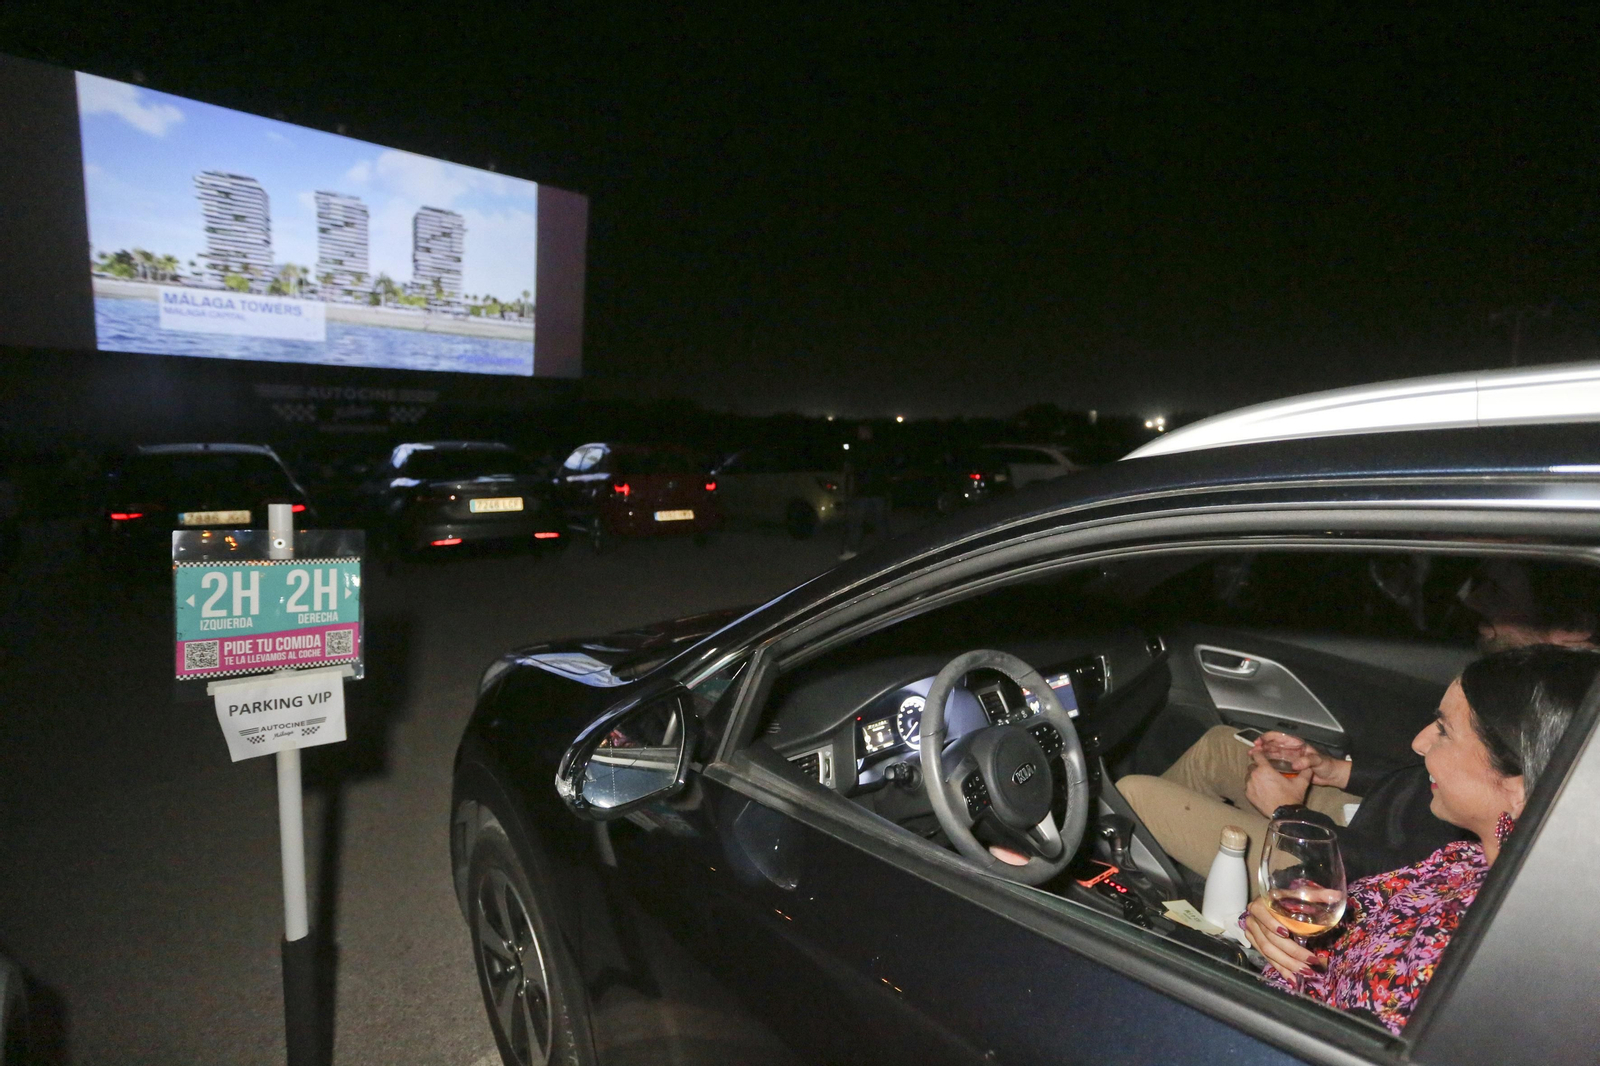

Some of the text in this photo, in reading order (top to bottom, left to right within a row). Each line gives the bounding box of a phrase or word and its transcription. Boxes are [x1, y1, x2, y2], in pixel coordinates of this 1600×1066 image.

[163, 291, 303, 317] MÁLAGA TOWERS
[306, 386, 397, 401] AUTOCINE
[200, 568, 338, 618] 2H 2H
[200, 616, 253, 631] IZQUIERDA
[298, 611, 339, 625] DERECHA
[224, 634, 322, 656] PIDE TU COMIDA
[224, 648, 322, 666] TE LA LLEVAMOS AL COCHE
[228, 691, 332, 717] PARKING VIP
[260, 720, 307, 732] AUTOCINE
[1015, 764, 1035, 785] KIA
